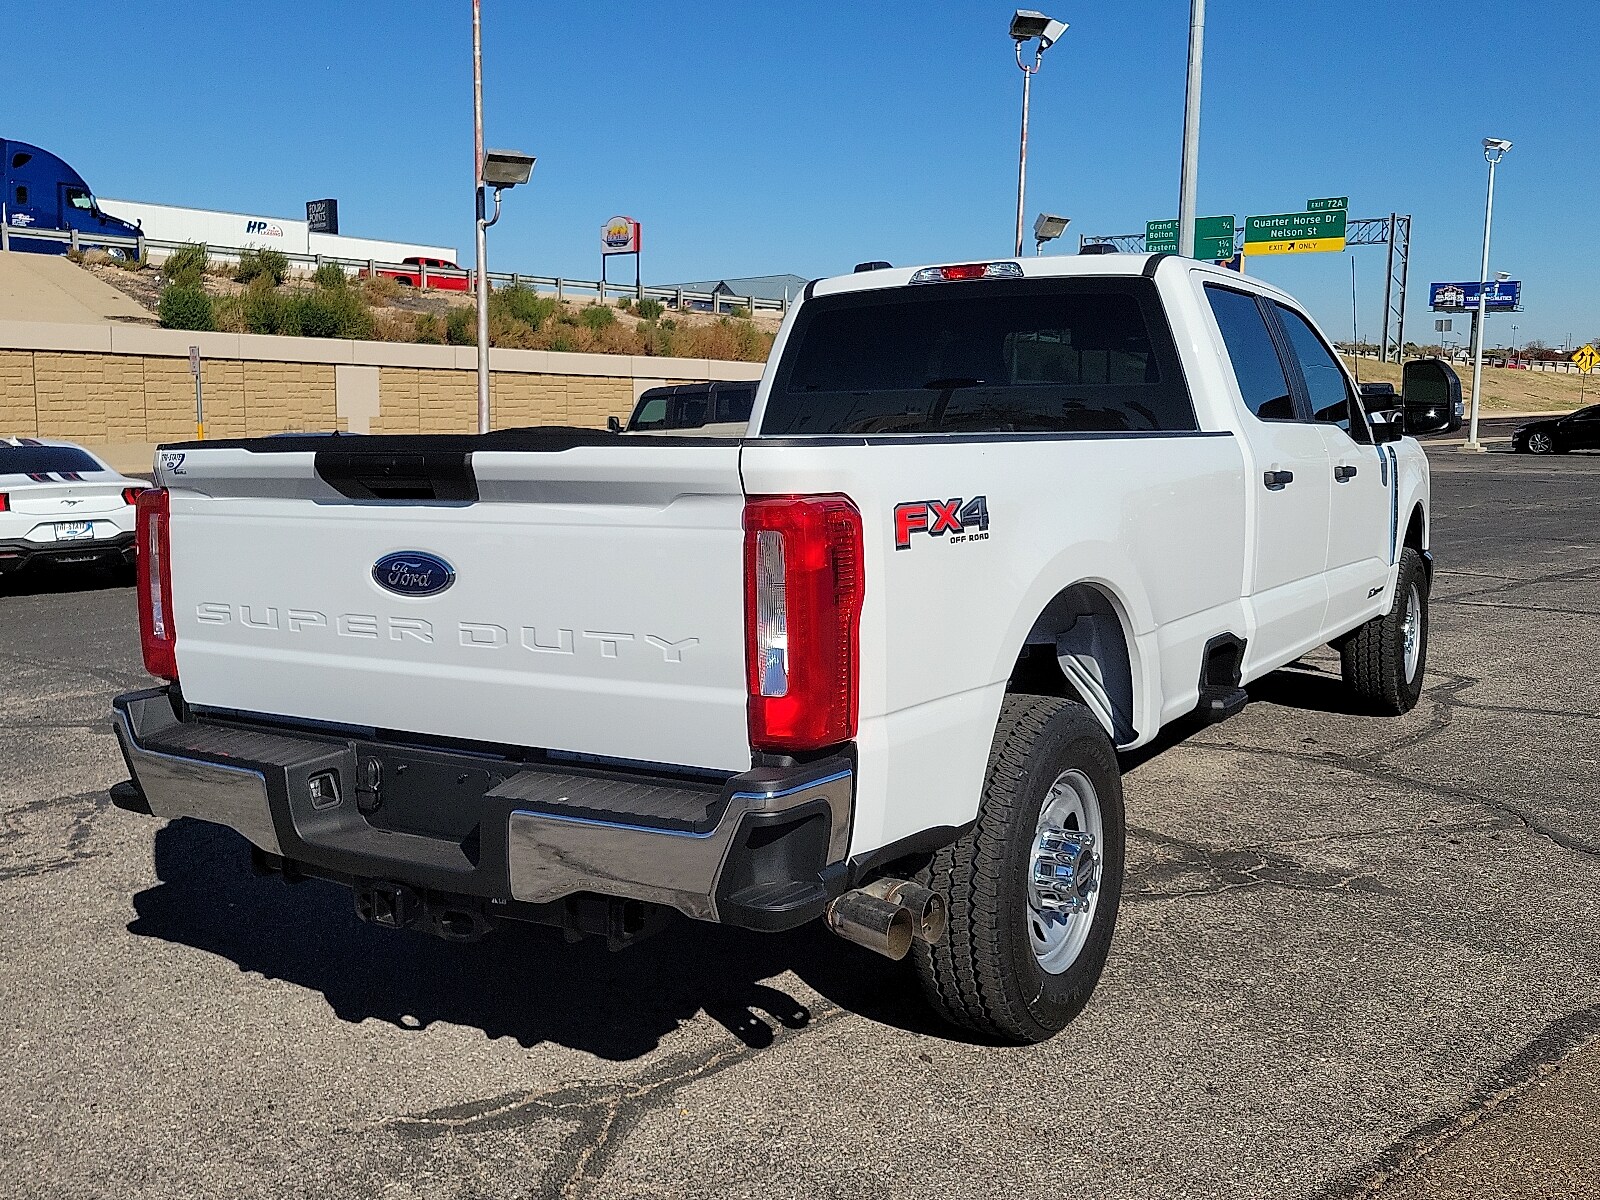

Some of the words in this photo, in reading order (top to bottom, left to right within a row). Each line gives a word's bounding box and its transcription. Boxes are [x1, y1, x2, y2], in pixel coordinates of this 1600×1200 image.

[1311, 201, 1324, 209] EXIT
[1327, 199, 1343, 208] 72A
[1149, 222, 1172, 230] Grand
[1253, 217, 1289, 228] Quarter
[1293, 216, 1321, 225] Horse
[1325, 214, 1337, 223] Dr
[246, 220, 267, 235] HP
[1270, 228, 1303, 238] Nelson
[1307, 226, 1318, 236] St
[1149, 231, 1174, 239] Bolton
[1148, 244, 1177, 252] Eastern
[1298, 242, 1317, 250] ONLY
[893, 495, 989, 551] FX4
[950, 535, 967, 544] OFF
[968, 532, 990, 542] ROAD
[388, 561, 433, 587] Ford
[196, 601, 435, 644] SUPER
[459, 620, 701, 664] DUTY
